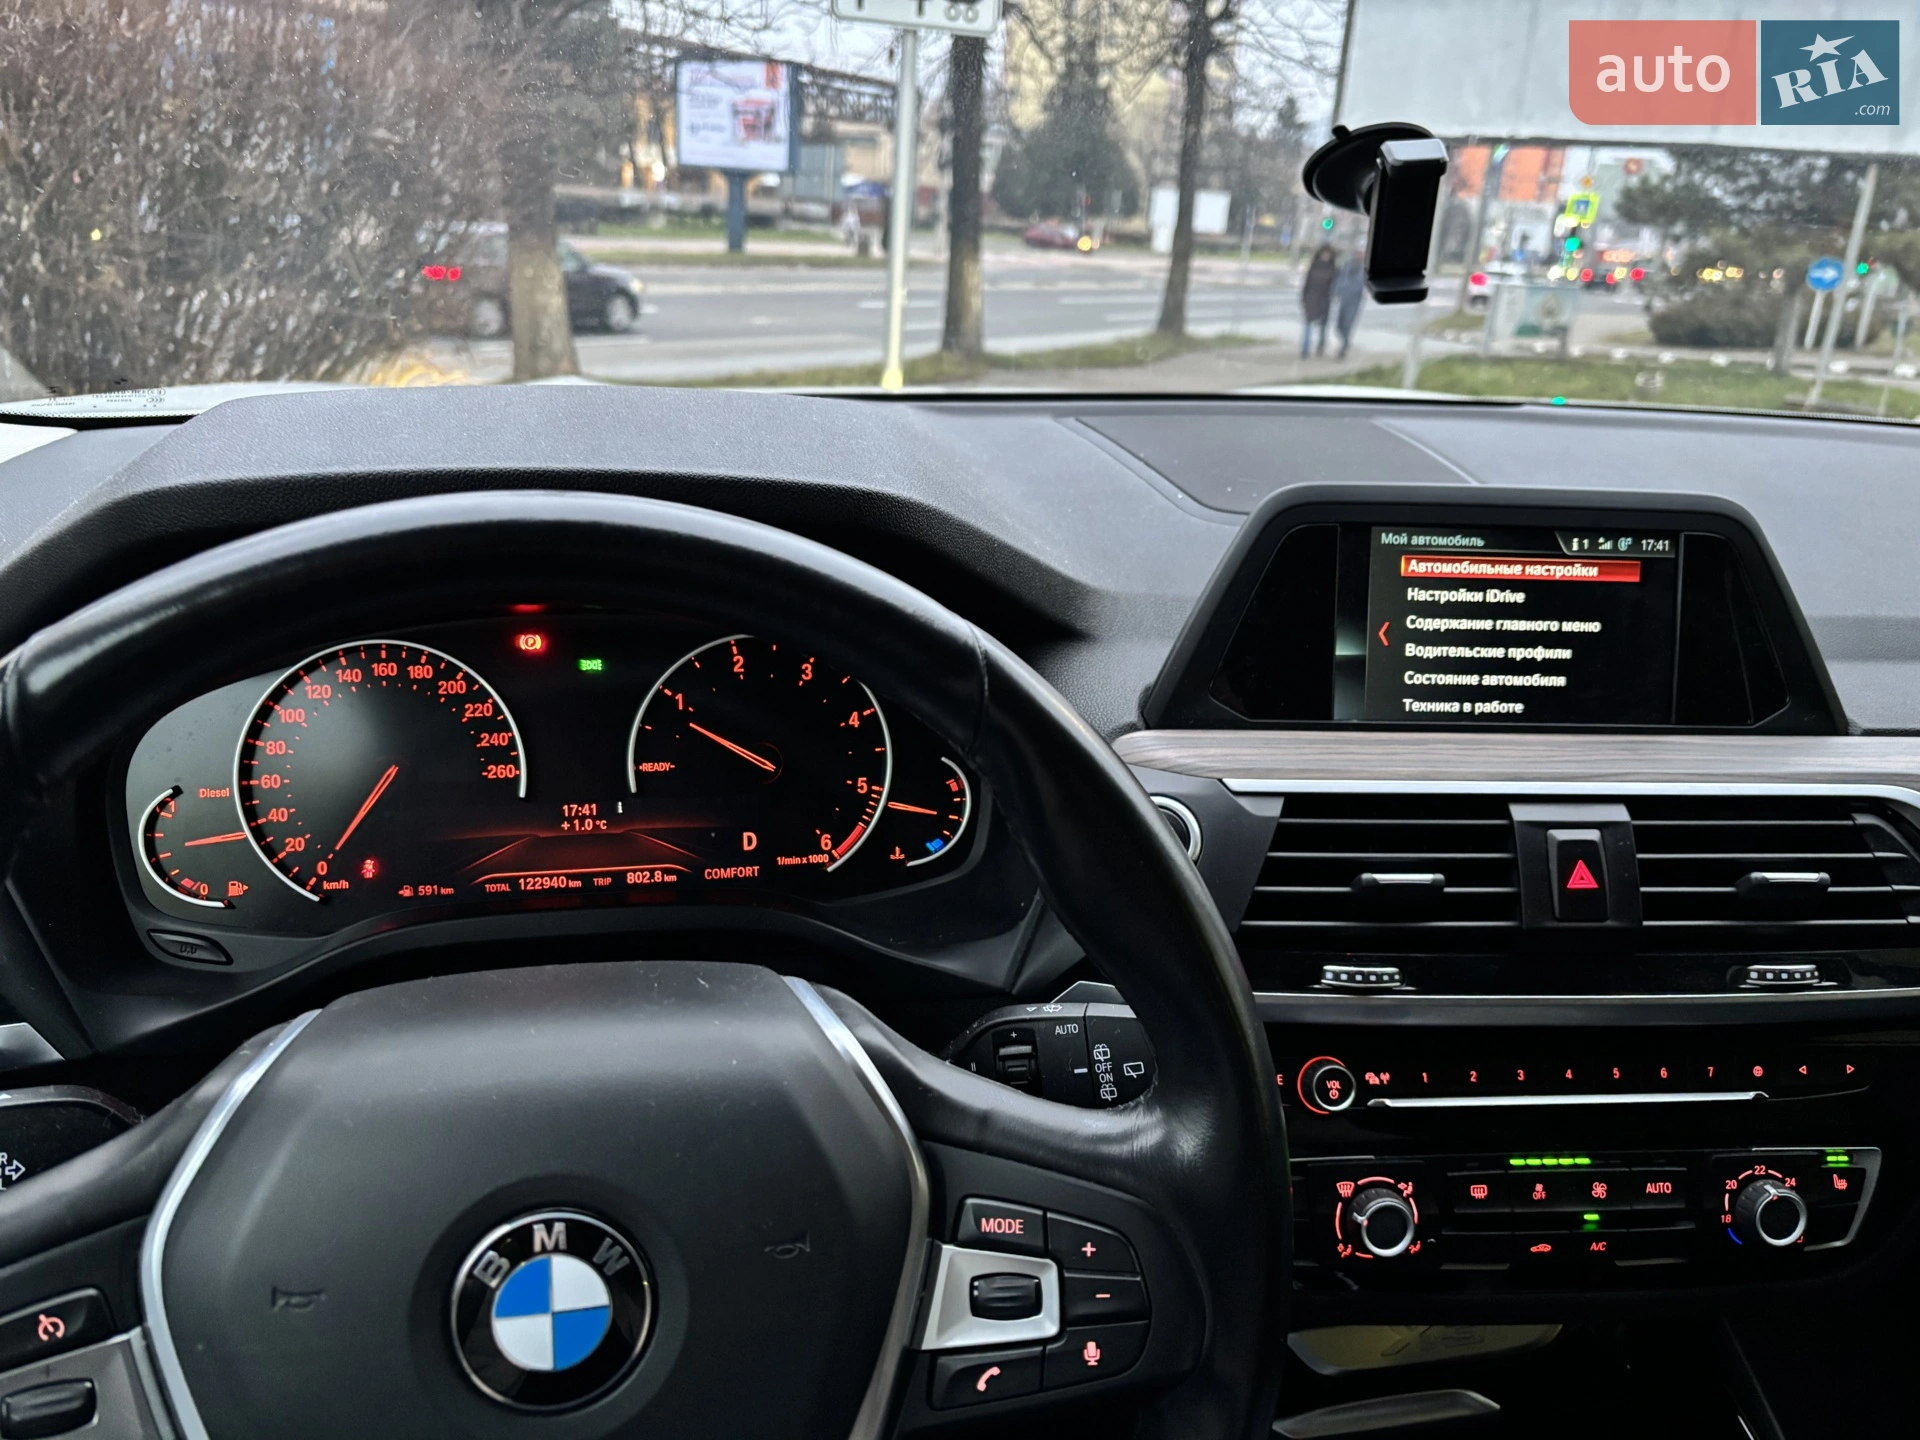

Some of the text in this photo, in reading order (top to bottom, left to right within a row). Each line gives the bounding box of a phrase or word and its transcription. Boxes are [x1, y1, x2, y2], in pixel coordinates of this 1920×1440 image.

[1381, 532, 1485, 548] Мой автомобиль
[1640, 539, 1670, 551] 17:41
[1408, 559, 1599, 579] Автомобильные настройки
[1407, 588, 1526, 604] Настройки iDrive
[1406, 615, 1602, 633] Содержание главного меню
[1405, 643, 1572, 662] Водительские профили
[371, 663, 398, 677] 160
[733, 656, 744, 673] 2
[336, 669, 362, 683] 140
[407, 665, 433, 680] 180
[801, 664, 813, 681] 3
[1404, 671, 1567, 688] Состояние автомобиля
[305, 686, 332, 700] 120
[438, 681, 467, 695] 200
[675, 693, 684, 710] 1
[1403, 699, 1525, 716] Техника в работе
[279, 709, 306, 723] 100
[465, 703, 493, 718] 220
[848, 712, 860, 728] 4
[480, 733, 509, 747] 240
[266, 741, 286, 755] 80
[261, 775, 281, 789] 60
[857, 777, 868, 794] 5
[199, 788, 230, 798] Diesel
[268, 808, 288, 822] 40
[562, 803, 597, 817] 17:41
[285, 838, 305, 852] 20
[743, 831, 757, 851] D
[820, 834, 832, 851] 6
[316, 861, 328, 875] 0
[704, 866, 760, 880] COMFORT
[323, 879, 349, 891] km/h
[485, 870, 677, 893] TOTAL 122940 km TRIP 802.8 km
[418, 885, 454, 896] 591 km
[1055, 1024, 1079, 1035] AUTO
[1095, 1062, 1112, 1073] OFF
[1565, 1069, 1573, 1079] 4
[1613, 1067, 1620, 1079] 5
[1660, 1067, 1668, 1079] 6
[1707, 1066, 1714, 1077] 7
[1099, 1073, 1114, 1083] ON
[1421, 1072, 1428, 1083] 1
[1470, 1071, 1477, 1082] 2
[1517, 1070, 1524, 1081] 3
[1326, 1080, 1341, 1089] VOL
[1754, 1165, 1766, 1175] 22
[1646, 1183, 1672, 1194] AUTO
[1725, 1180, 1737, 1190] 20
[1784, 1178, 1796, 1187] 24
[1532, 1191, 1546, 1200] OFF
[981, 1218, 1024, 1234] MODE
[1721, 1214, 1732, 1224] 18
[1590, 1241, 1607, 1252] A/C
[472, 1222, 630, 1289] BMW
